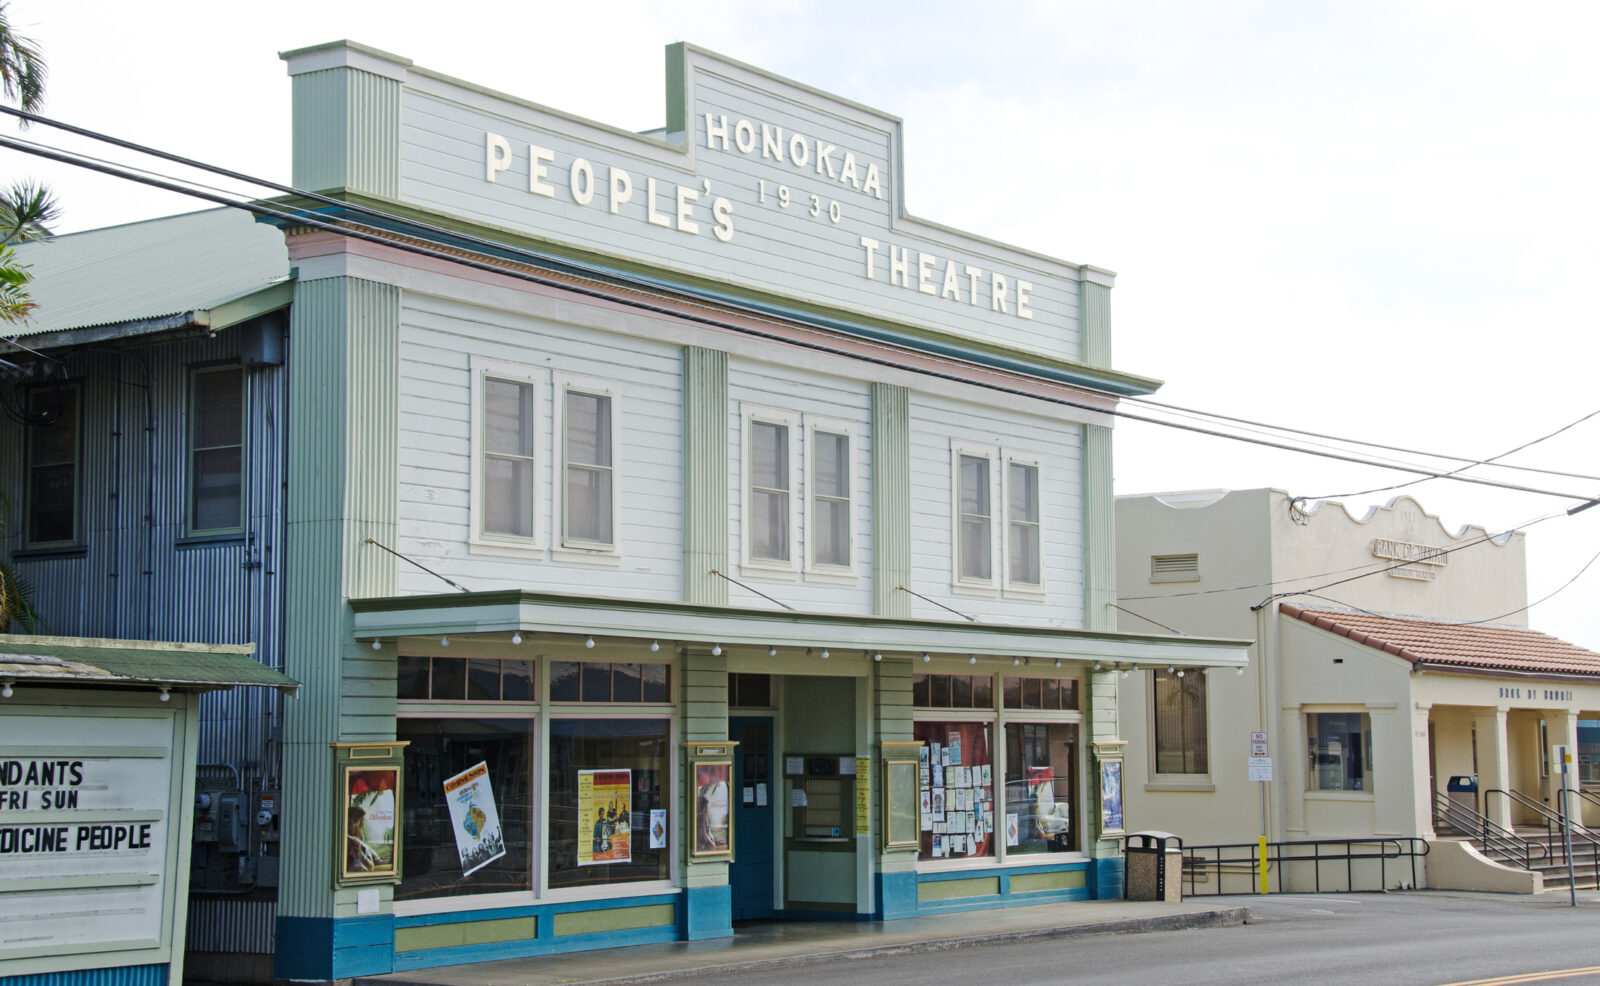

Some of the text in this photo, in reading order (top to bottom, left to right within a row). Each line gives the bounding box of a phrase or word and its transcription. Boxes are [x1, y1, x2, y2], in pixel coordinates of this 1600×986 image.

[705, 113, 882, 200] HONOKAA
[484, 131, 735, 242] PEOPLE'S
[860, 236, 1033, 320] THEATRE
[1377, 540, 1400, 558] BANK
[0, 790, 78, 809] FRI SUN
[0, 824, 151, 853] DICINE PEOPLE
